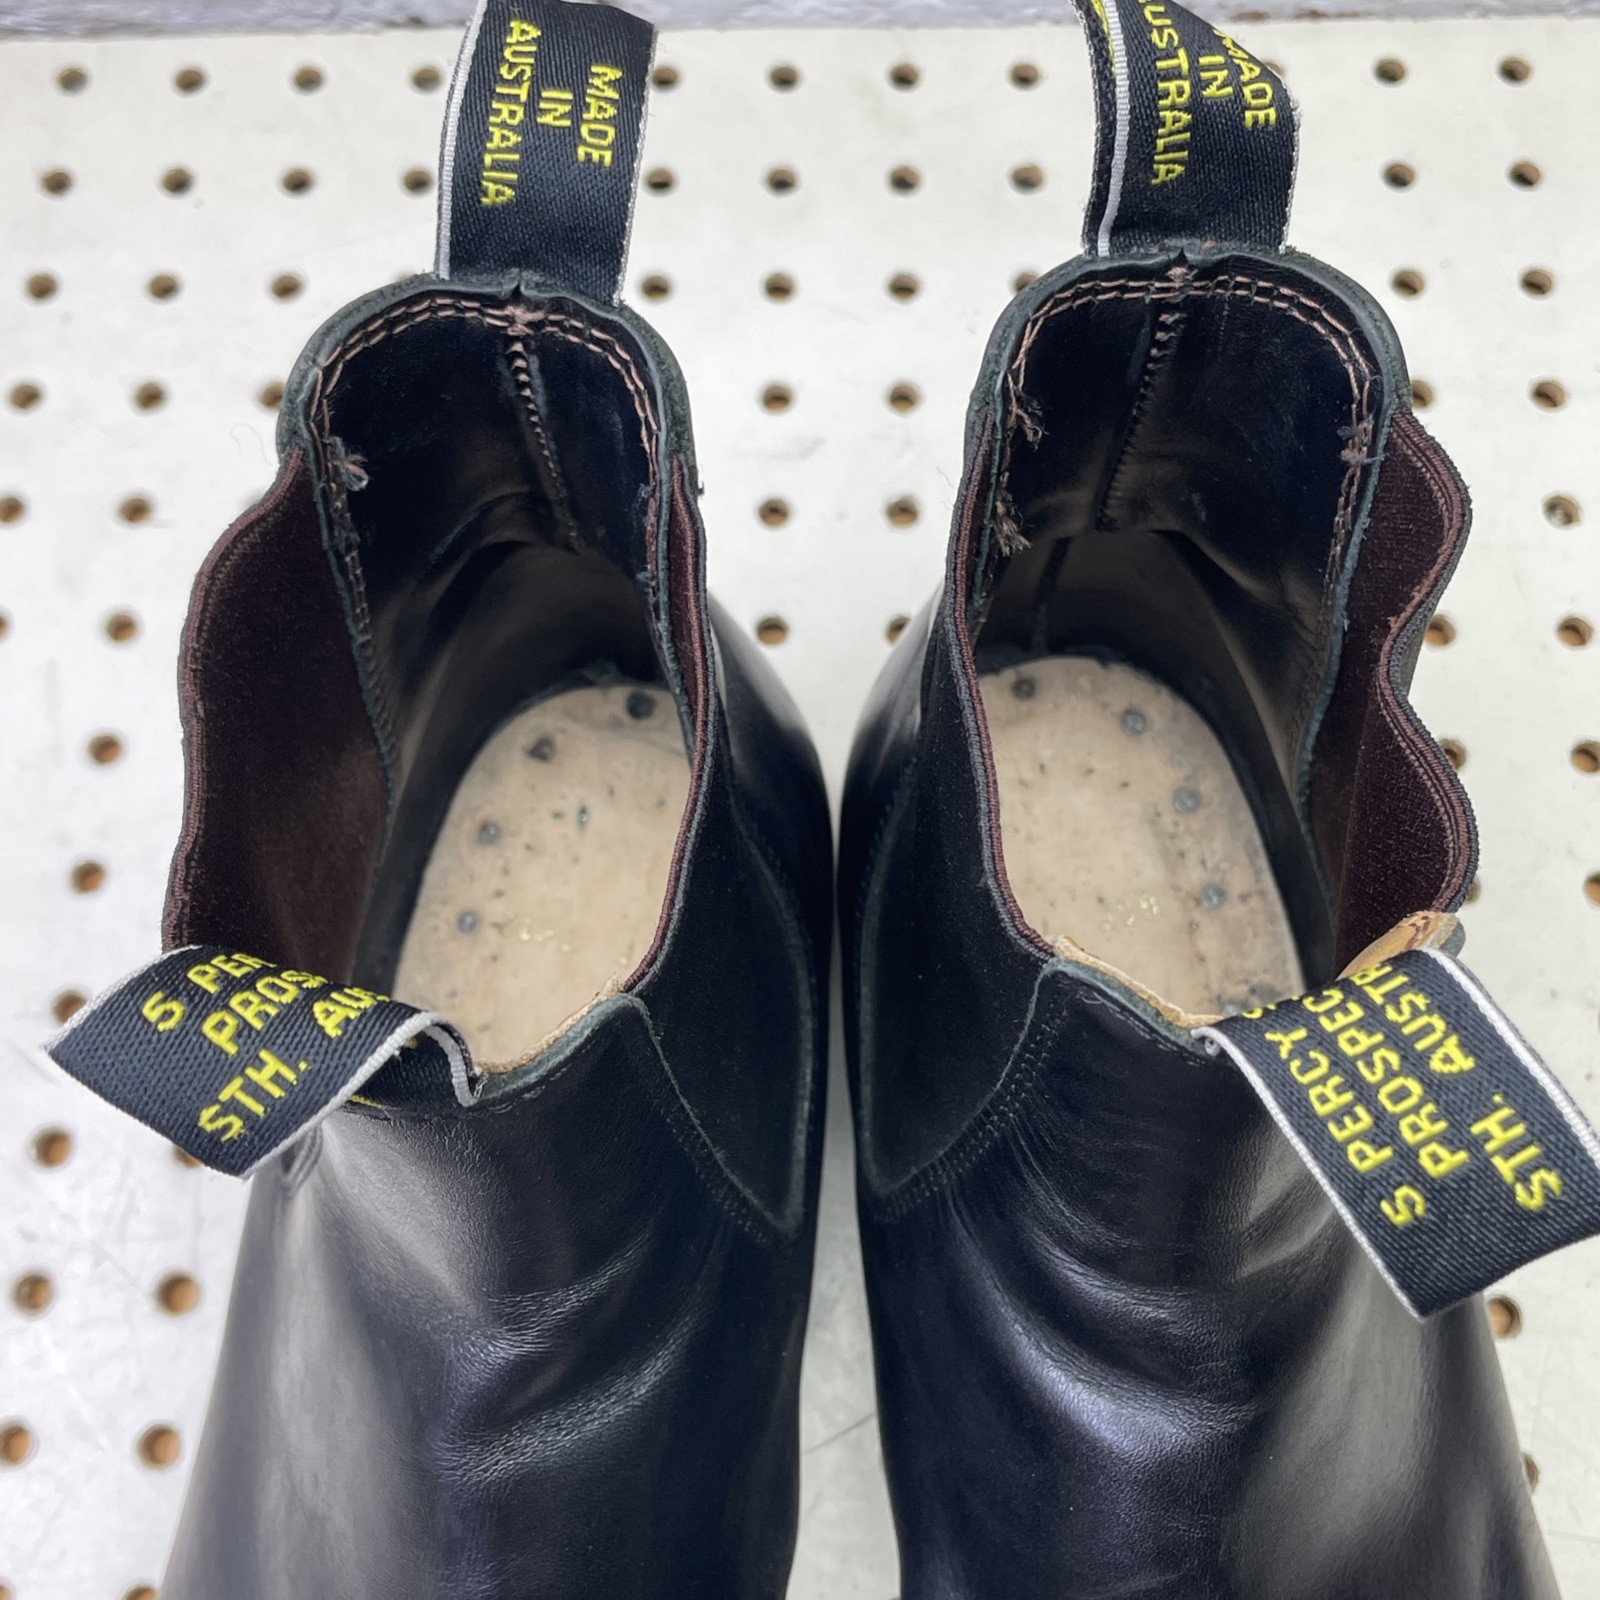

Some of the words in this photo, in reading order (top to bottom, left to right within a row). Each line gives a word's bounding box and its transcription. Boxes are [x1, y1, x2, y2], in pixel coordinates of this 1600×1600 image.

[480, 20, 542, 206] AUSTRALIA
[537, 90, 573, 127] IN
[577, 64, 623, 167] MADE
[1138, 0, 1192, 185] USTRALIA
[1199, 55, 1233, 98] IN
[142, 991, 185, 1032] S
[186, 953, 277, 994] PER
[199, 1048, 310, 1142] STH.
[312, 987, 391, 1038] AU
[1264, 1027, 1393, 1173] PERCY
[1291, 987, 1469, 1178] PROSPEC
[1380, 1185, 1426, 1226] S
[1470, 1093, 1564, 1210] STH.
